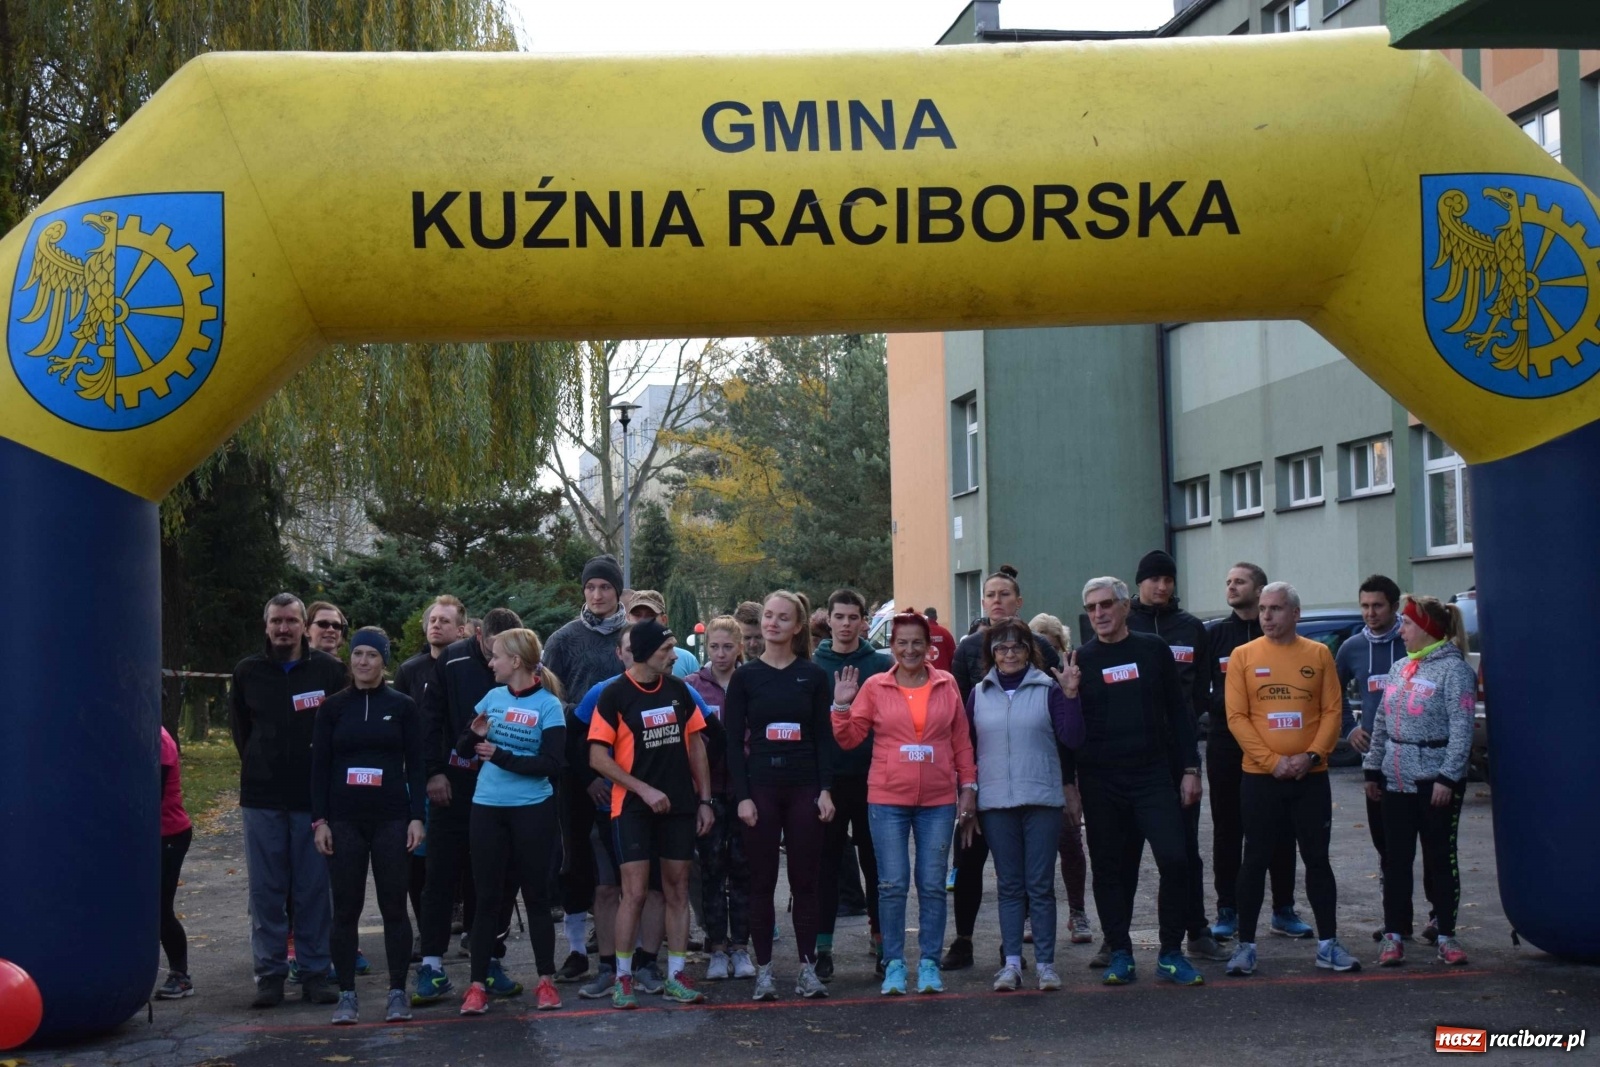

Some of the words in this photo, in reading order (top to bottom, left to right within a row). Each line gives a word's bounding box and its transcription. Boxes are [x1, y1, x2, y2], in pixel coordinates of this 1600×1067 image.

[701, 98, 957, 153] GMINA
[412, 176, 705, 250] KUŹNIA
[728, 180, 1240, 247] RACIBORSKA
[1112, 670, 1129, 681] 040
[304, 696, 320, 708] 015
[512, 713, 529, 724] 110
[652, 713, 669, 725] 091
[1277, 717, 1293, 728] 112
[494, 729, 509, 738] Klub
[642, 723, 680, 741] ZAWISZA
[777, 729, 793, 739] 107
[908, 751, 925, 761] 038
[356, 773, 373, 784] 081
